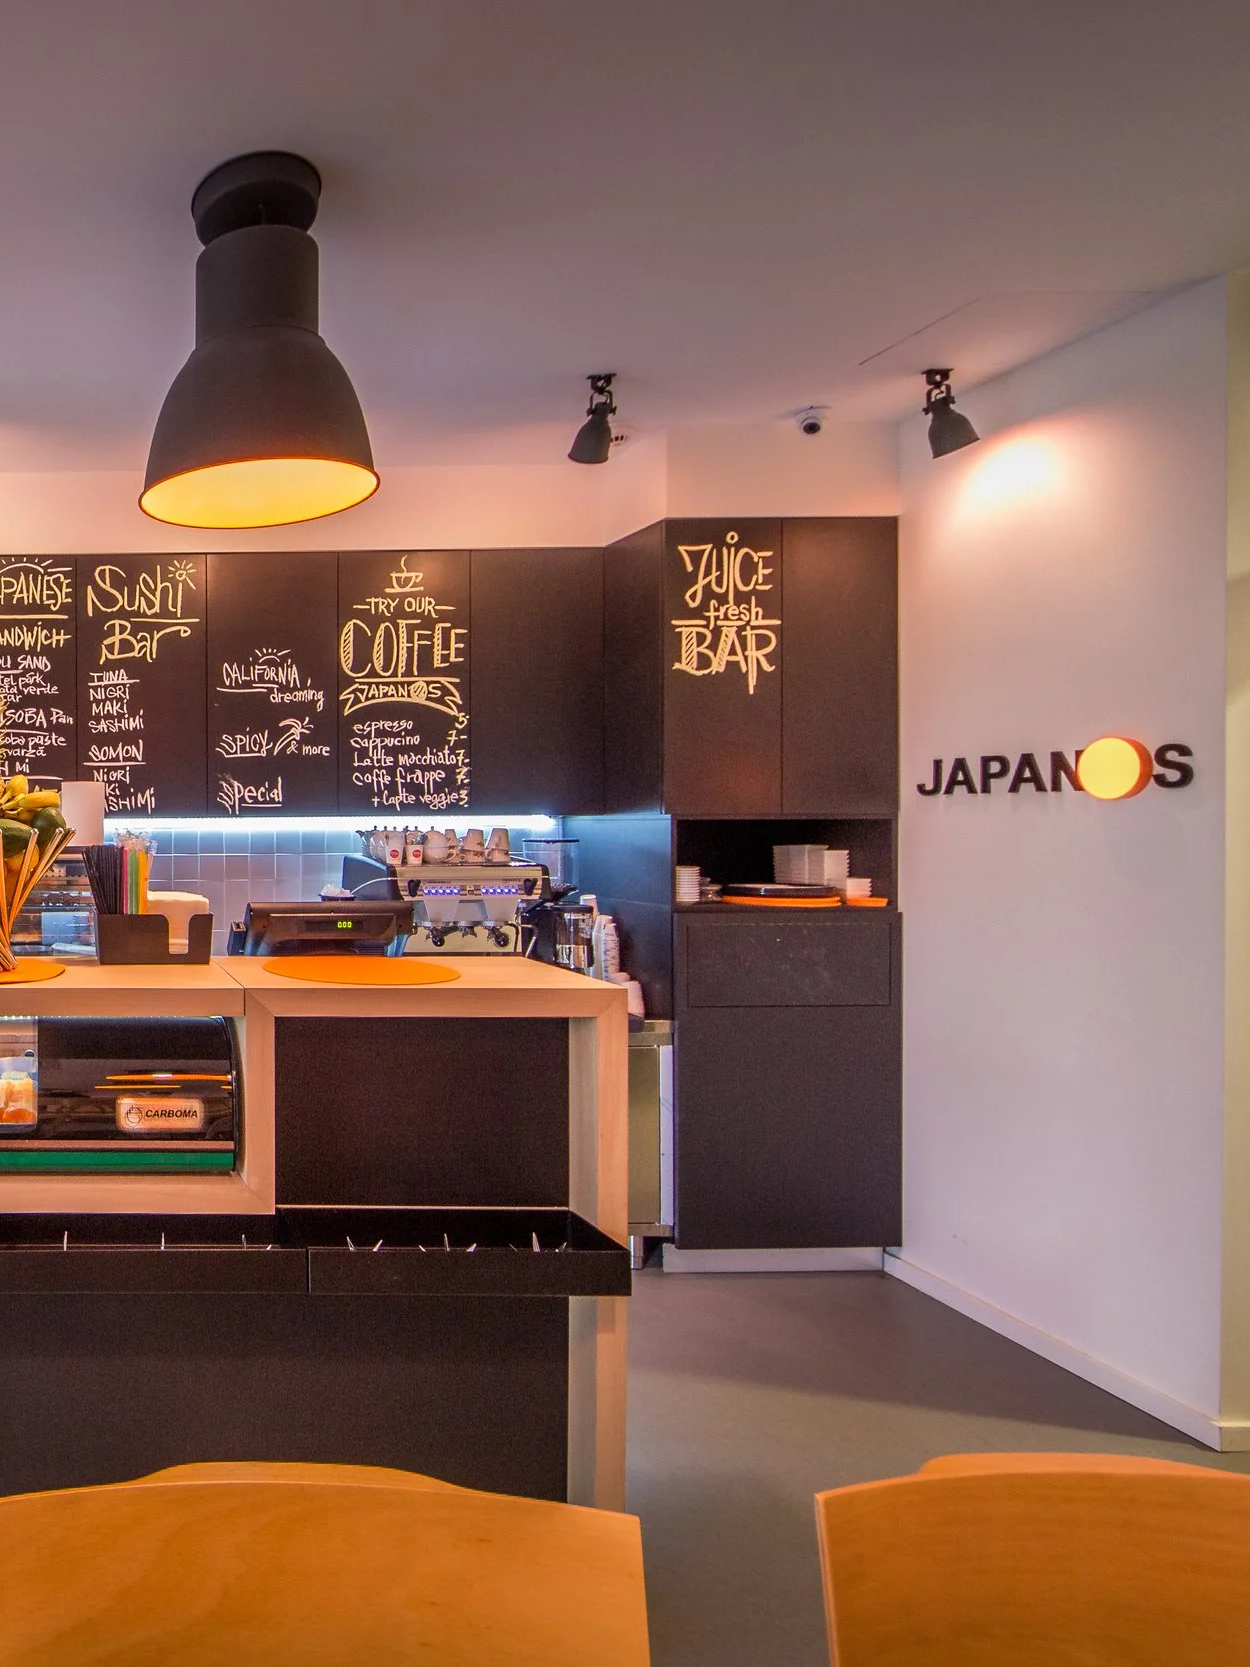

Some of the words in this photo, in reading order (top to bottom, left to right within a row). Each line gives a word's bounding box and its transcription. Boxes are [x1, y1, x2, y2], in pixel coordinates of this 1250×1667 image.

[87, 565, 188, 617] Sushi
[366, 596, 399, 617] TRY
[404, 596, 439, 618] OUR
[703, 596, 764, 630] fresh
[100, 619, 191, 665] Bar
[340, 619, 468, 678] COFFEE
[18, 655, 51, 672] SAND
[672, 625, 777, 695] BAR
[89, 669, 128, 683] TUNA
[270, 678, 325, 712] dreaming
[353, 720, 413, 740] espresso
[88, 739, 143, 763] SOMON
[302, 744, 331, 756] more
[353, 749, 394, 767] Latte
[399, 745, 456, 766] macchiato
[419, 788, 459, 809] veggie
[145, 1109, 198, 1119] CARBOMA
